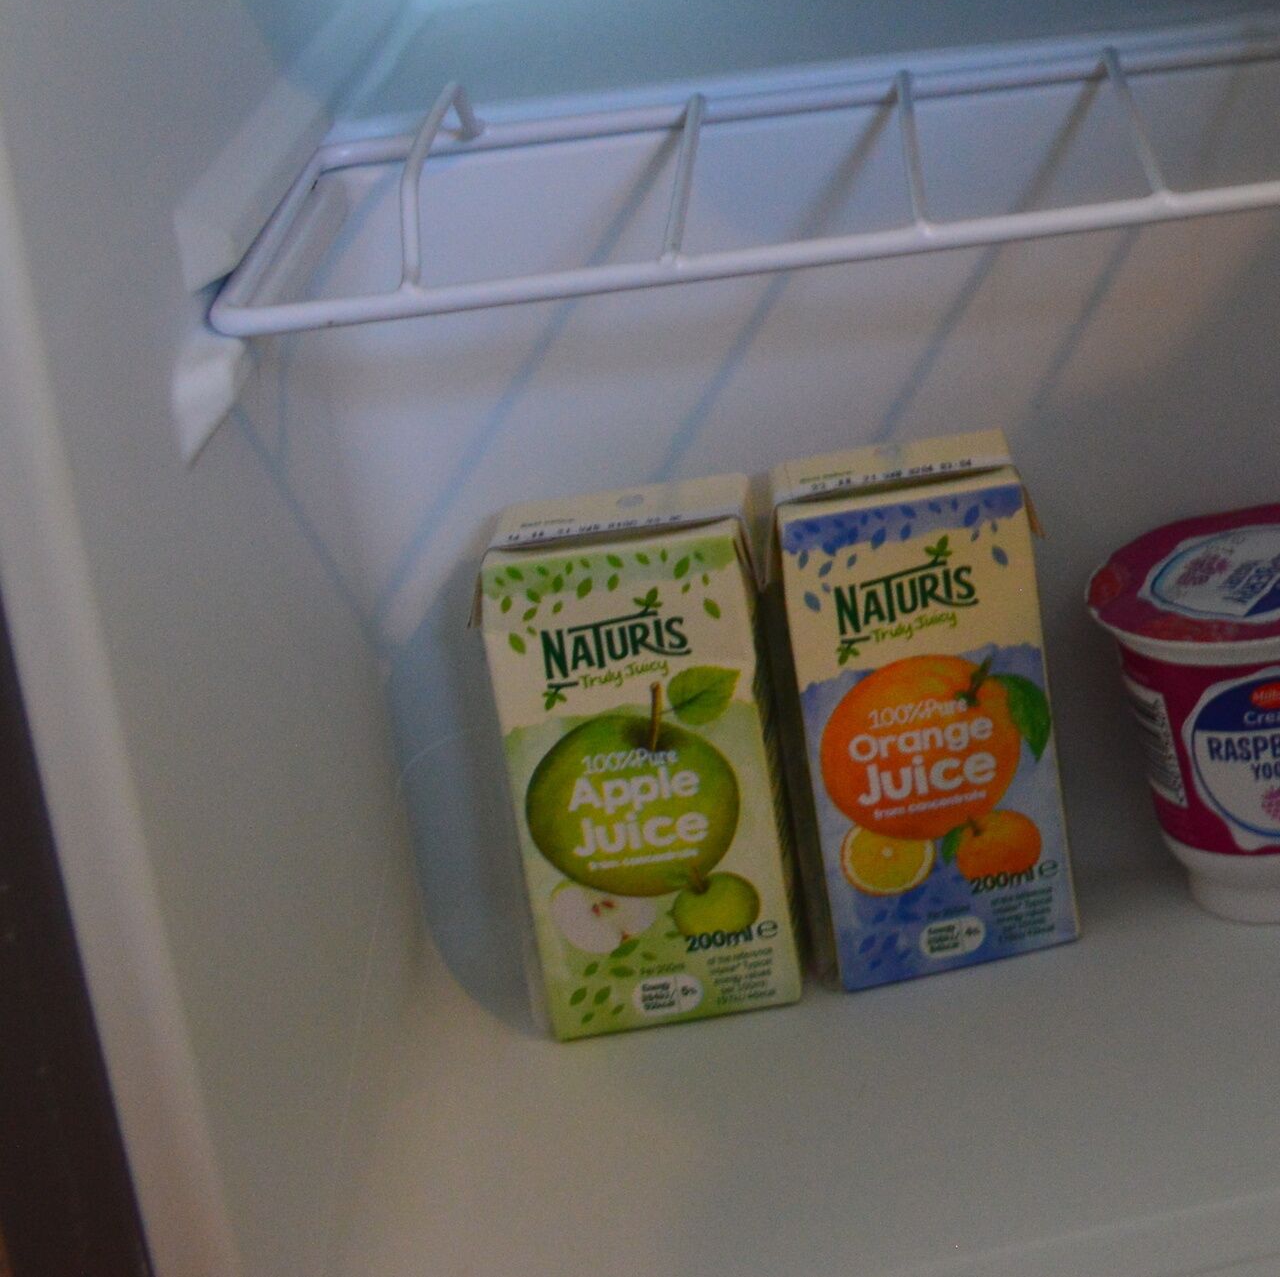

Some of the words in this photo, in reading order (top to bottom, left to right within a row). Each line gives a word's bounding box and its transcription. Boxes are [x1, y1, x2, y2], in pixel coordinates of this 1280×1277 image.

[834, 560, 980, 635] NATURIS
[541, 610, 693, 680] NATURIS
[579, 669, 625, 689] Truly
[624, 658, 670, 677] Juicy
[847, 716, 994, 763] Orange
[567, 765, 700, 815] Apple
[857, 752, 998, 806] Juice
[573, 811, 710, 857] Juice
[970, 864, 1035, 895] 200ml
[686, 925, 753, 953] 200ml
